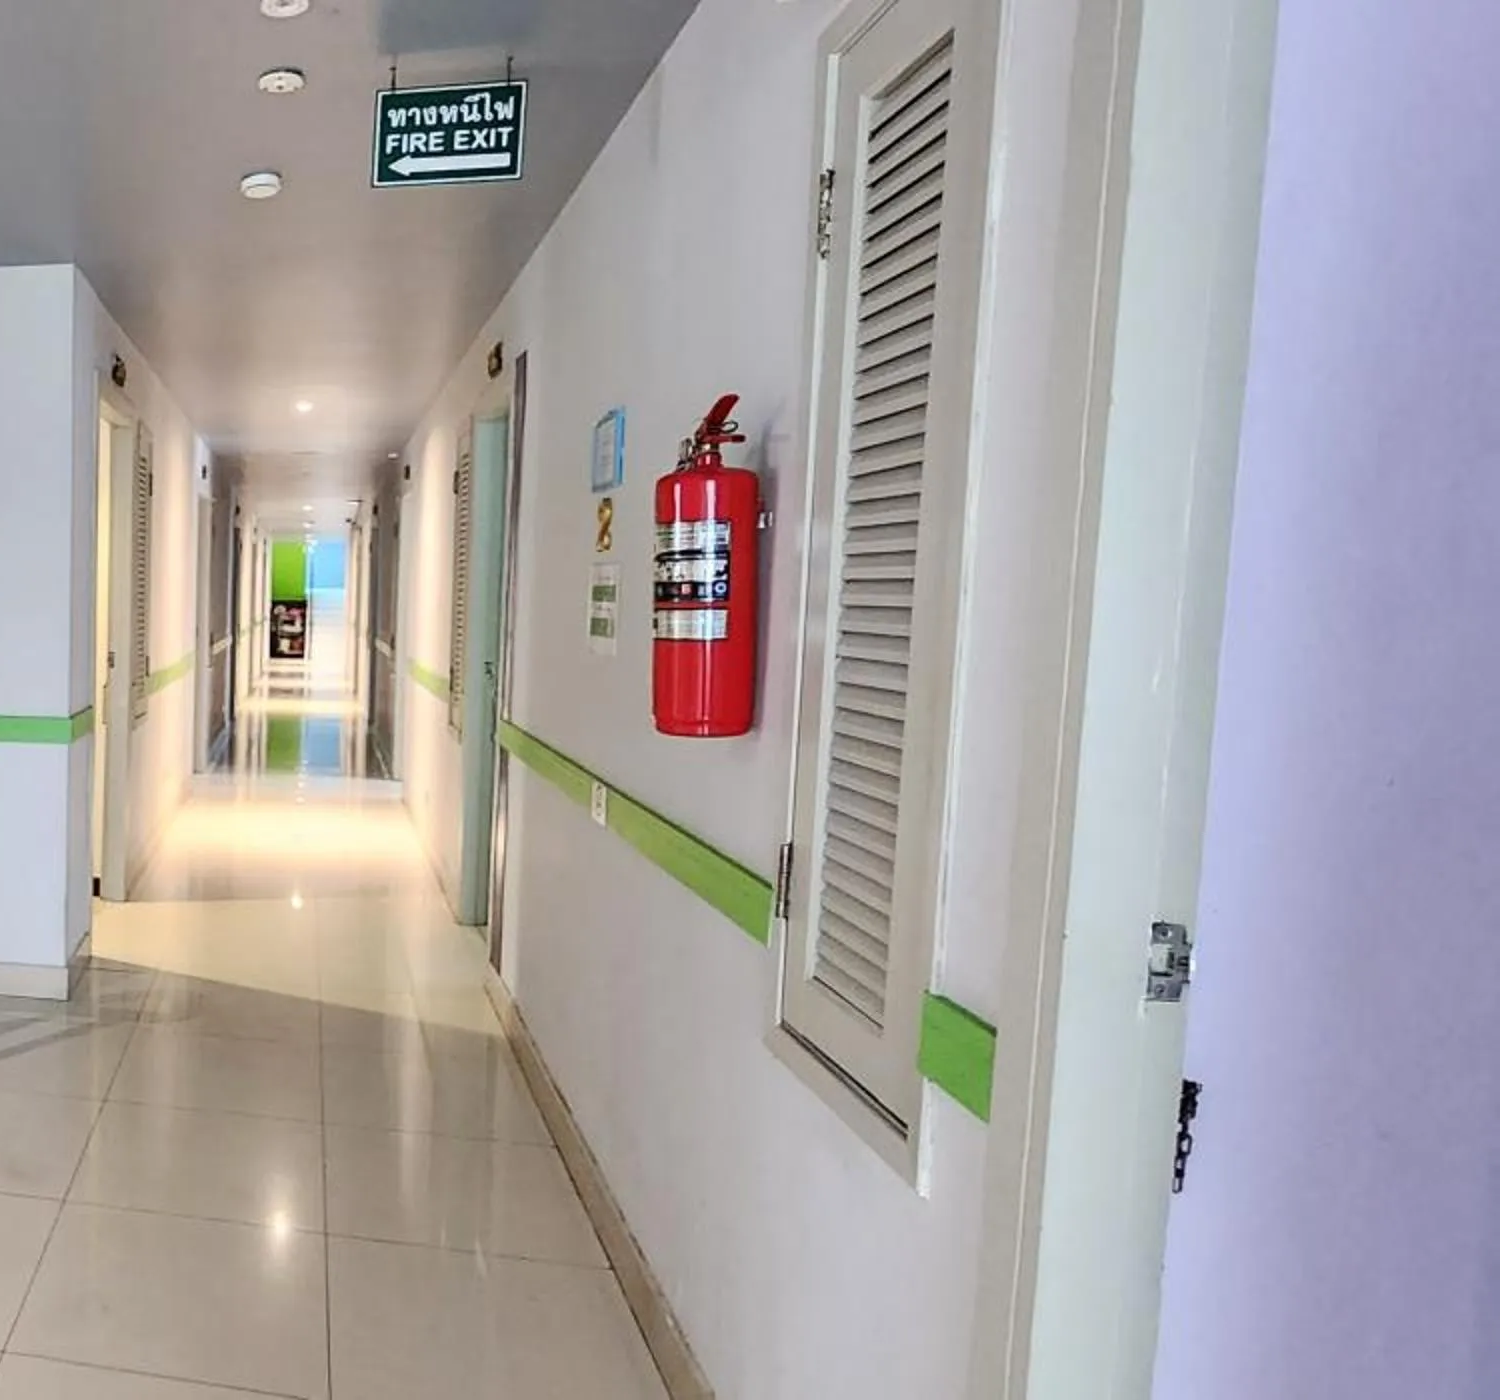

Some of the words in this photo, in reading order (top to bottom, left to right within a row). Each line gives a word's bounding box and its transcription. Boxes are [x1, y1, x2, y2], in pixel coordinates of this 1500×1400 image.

[387, 92, 515, 128] ทางหนีไฟ
[385, 131, 446, 155] FIRE
[453, 126, 514, 151] EXIT
